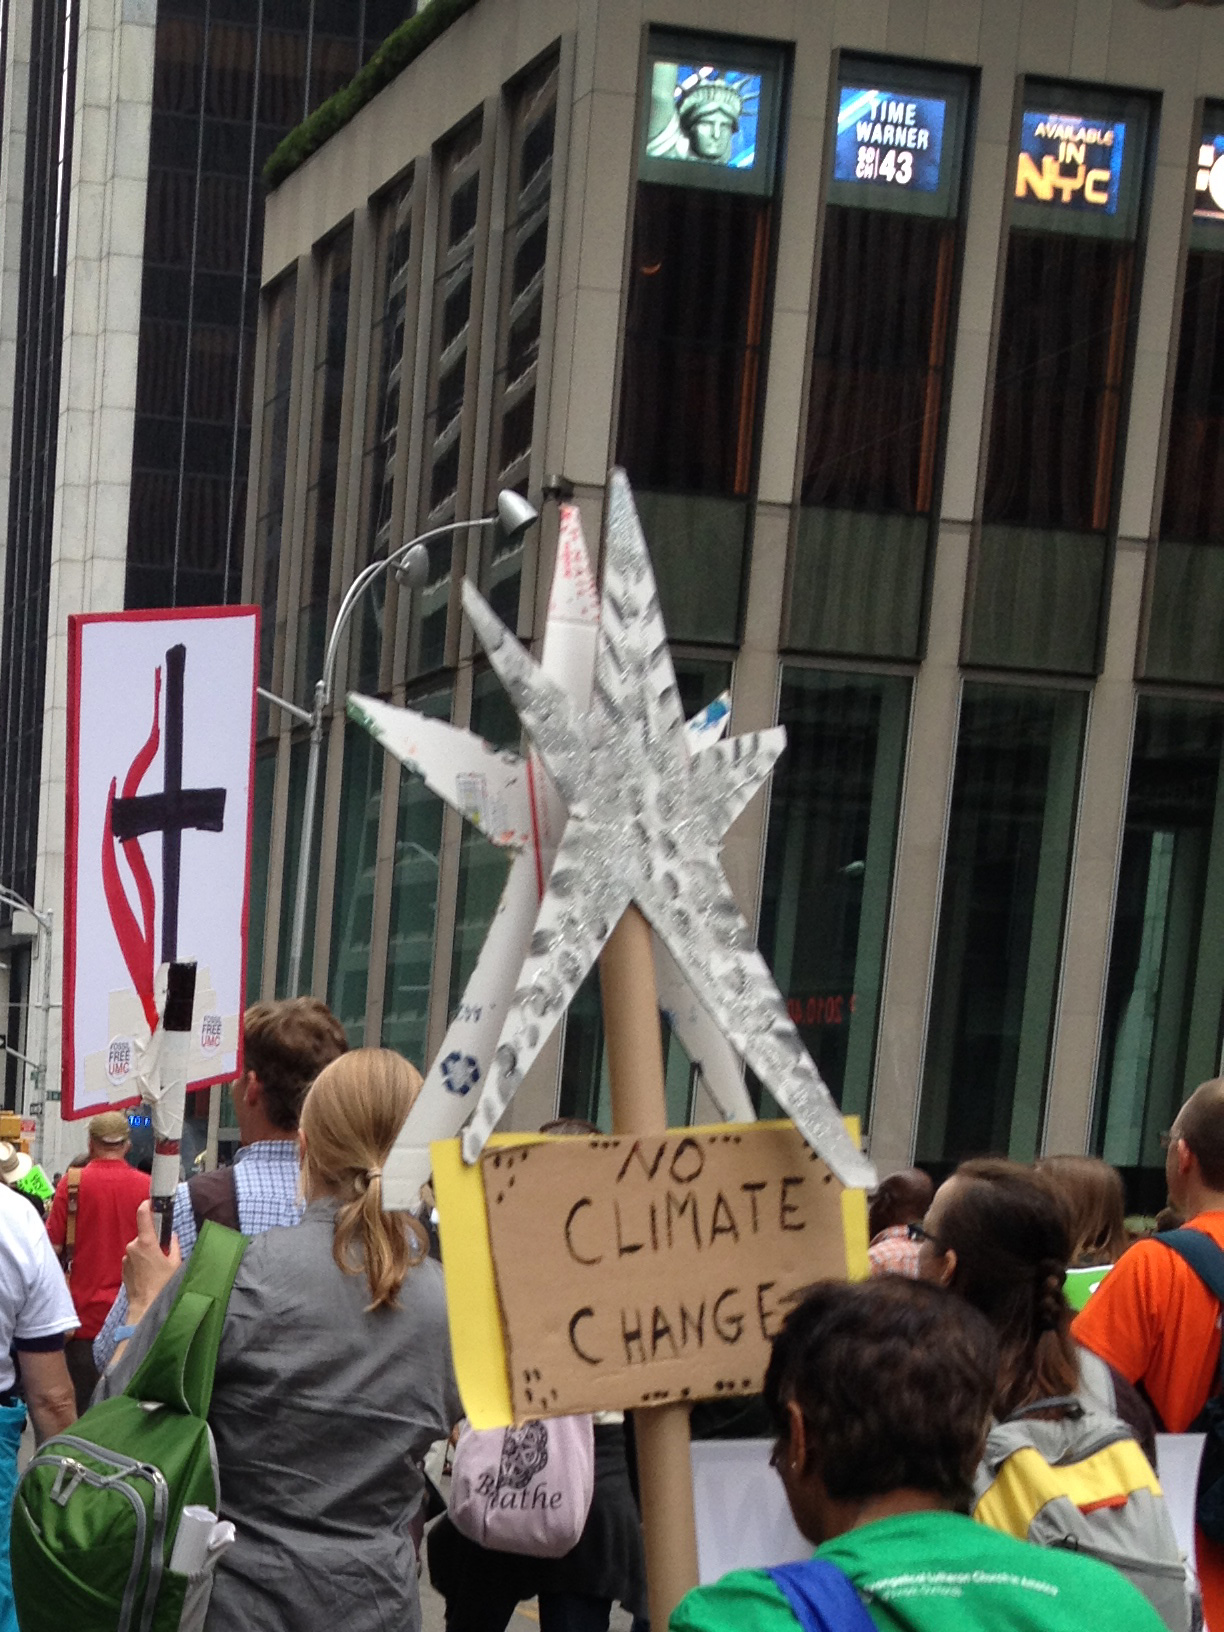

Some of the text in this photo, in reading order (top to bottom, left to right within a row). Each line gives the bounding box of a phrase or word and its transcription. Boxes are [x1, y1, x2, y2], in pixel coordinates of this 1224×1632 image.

[871, 99, 917, 126] TIME
[856, 121, 930, 151] WARNER
[1034, 122, 1115, 147] AVAILABLE
[879, 149, 914, 184] 43
[1059, 142, 1086, 165] IN
[1015, 153, 1111, 204] NYC
[202, 1024, 222, 1034] FREE
[202, 1034, 220, 1047] UMC
[108, 1050, 131, 1063] FREE
[109, 1040, 131, 1051] FOSSIL
[108, 1061, 130, 1076] UMC
[615, 1136, 706, 1184] NO
[564, 1176, 806, 1265] CLIMATE
[568, 1283, 778, 1365] CHANGE
